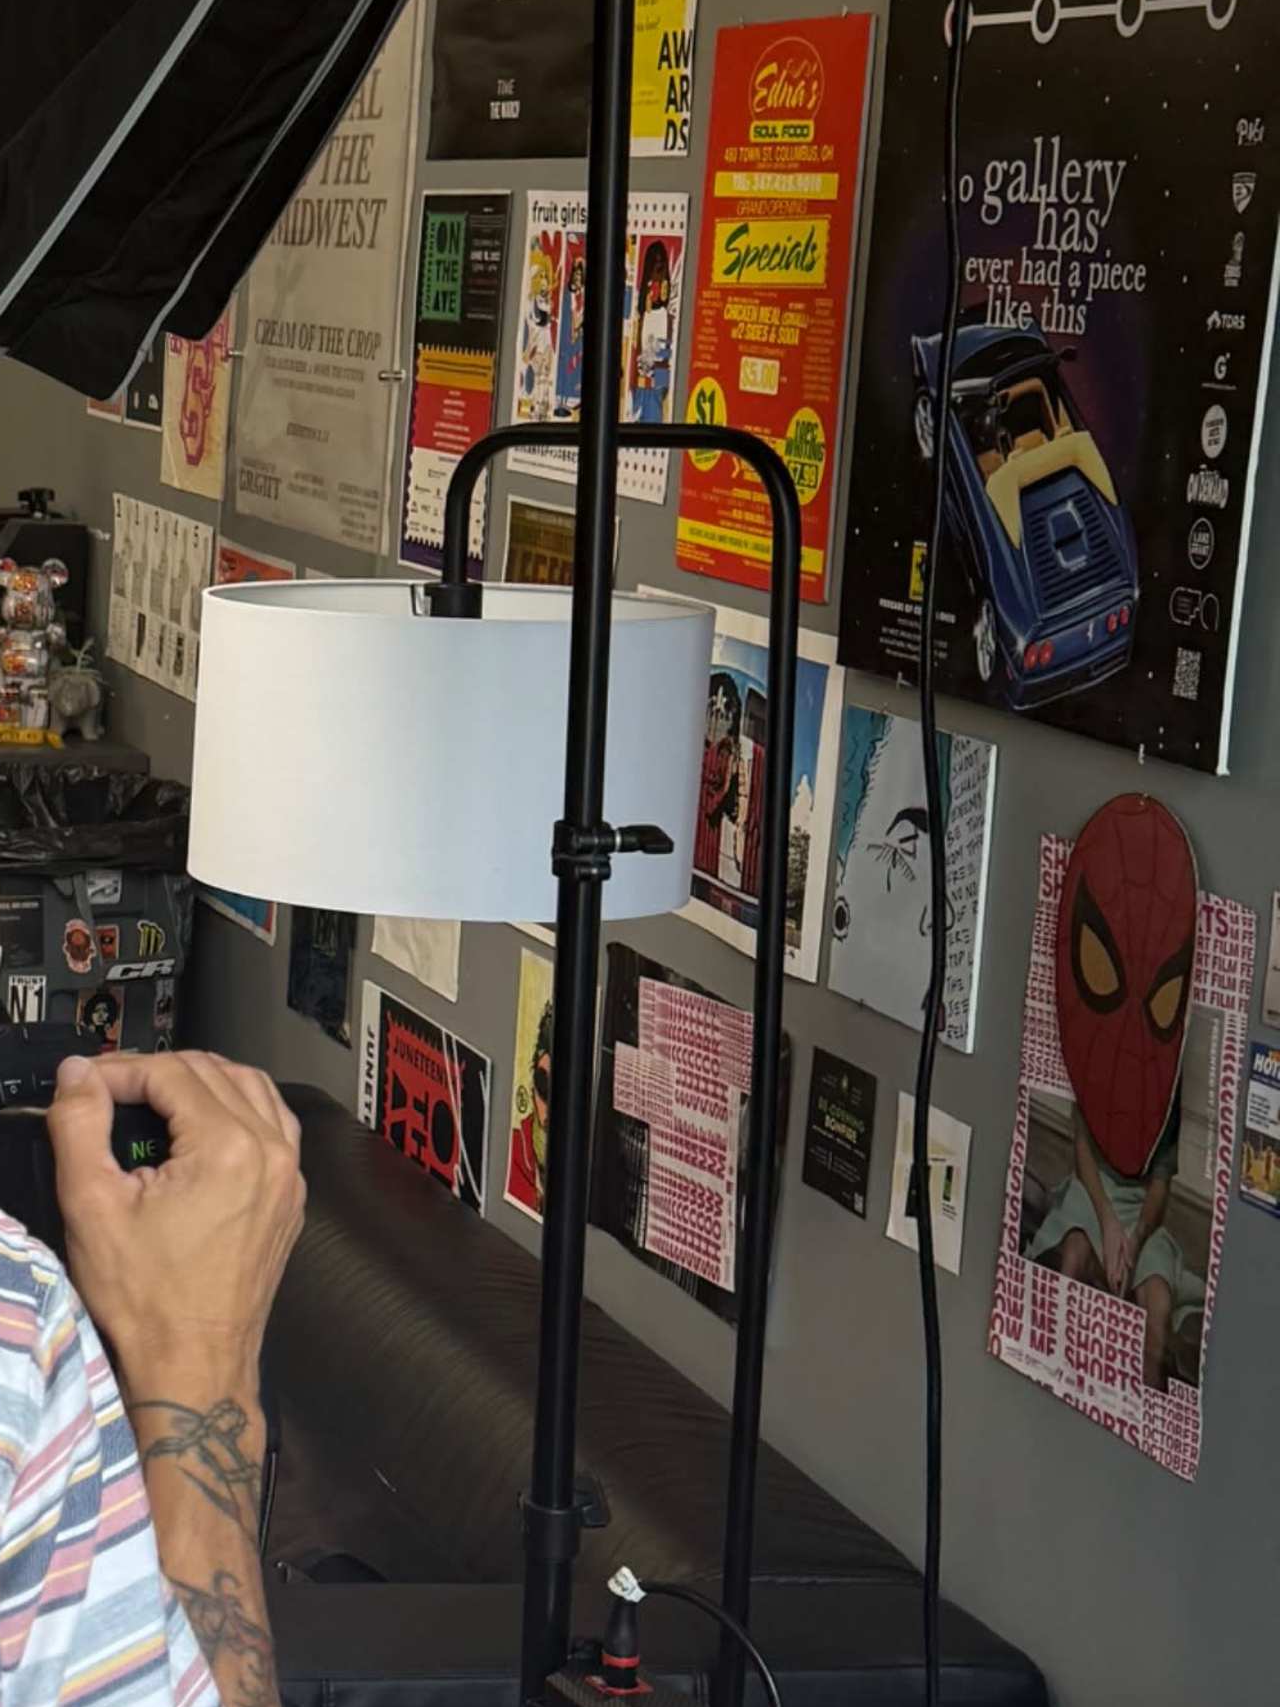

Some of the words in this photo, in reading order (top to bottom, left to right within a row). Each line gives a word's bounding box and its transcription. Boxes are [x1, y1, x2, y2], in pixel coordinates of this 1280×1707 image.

[752, 61, 821, 114] Edna's
[752, 124, 779, 139] SOUL
[781, 123, 811, 139] FOOD
[979, 134, 1128, 227] gallery
[269, 197, 389, 251] MIDWEST
[532, 200, 559, 225] fruit
[560, 200, 586, 228] girls
[1033, 182, 1102, 255] has
[437, 220, 461, 255] ON
[721, 220, 822, 282] Specials
[433, 258, 459, 284] THE
[963, 255, 1015, 284] ever
[1017, 246, 1062, 288] had
[1067, 260, 1082, 288] a
[1084, 247, 1148, 303] piece
[983, 283, 1033, 332] like
[1040, 287, 1088, 337] this
[254, 317, 297, 350] CREAM
[297, 322, 318, 352] OF
[316, 324, 345, 358] THE
[346, 329, 383, 362] CROP
[1209, 990, 1237, 1013] FILM
[1168, 1378, 1200, 1406] 2019
[1141, 1441, 1200, 1479] OCTOBER
[1142, 1422, 1200, 1460] OCTOBER
